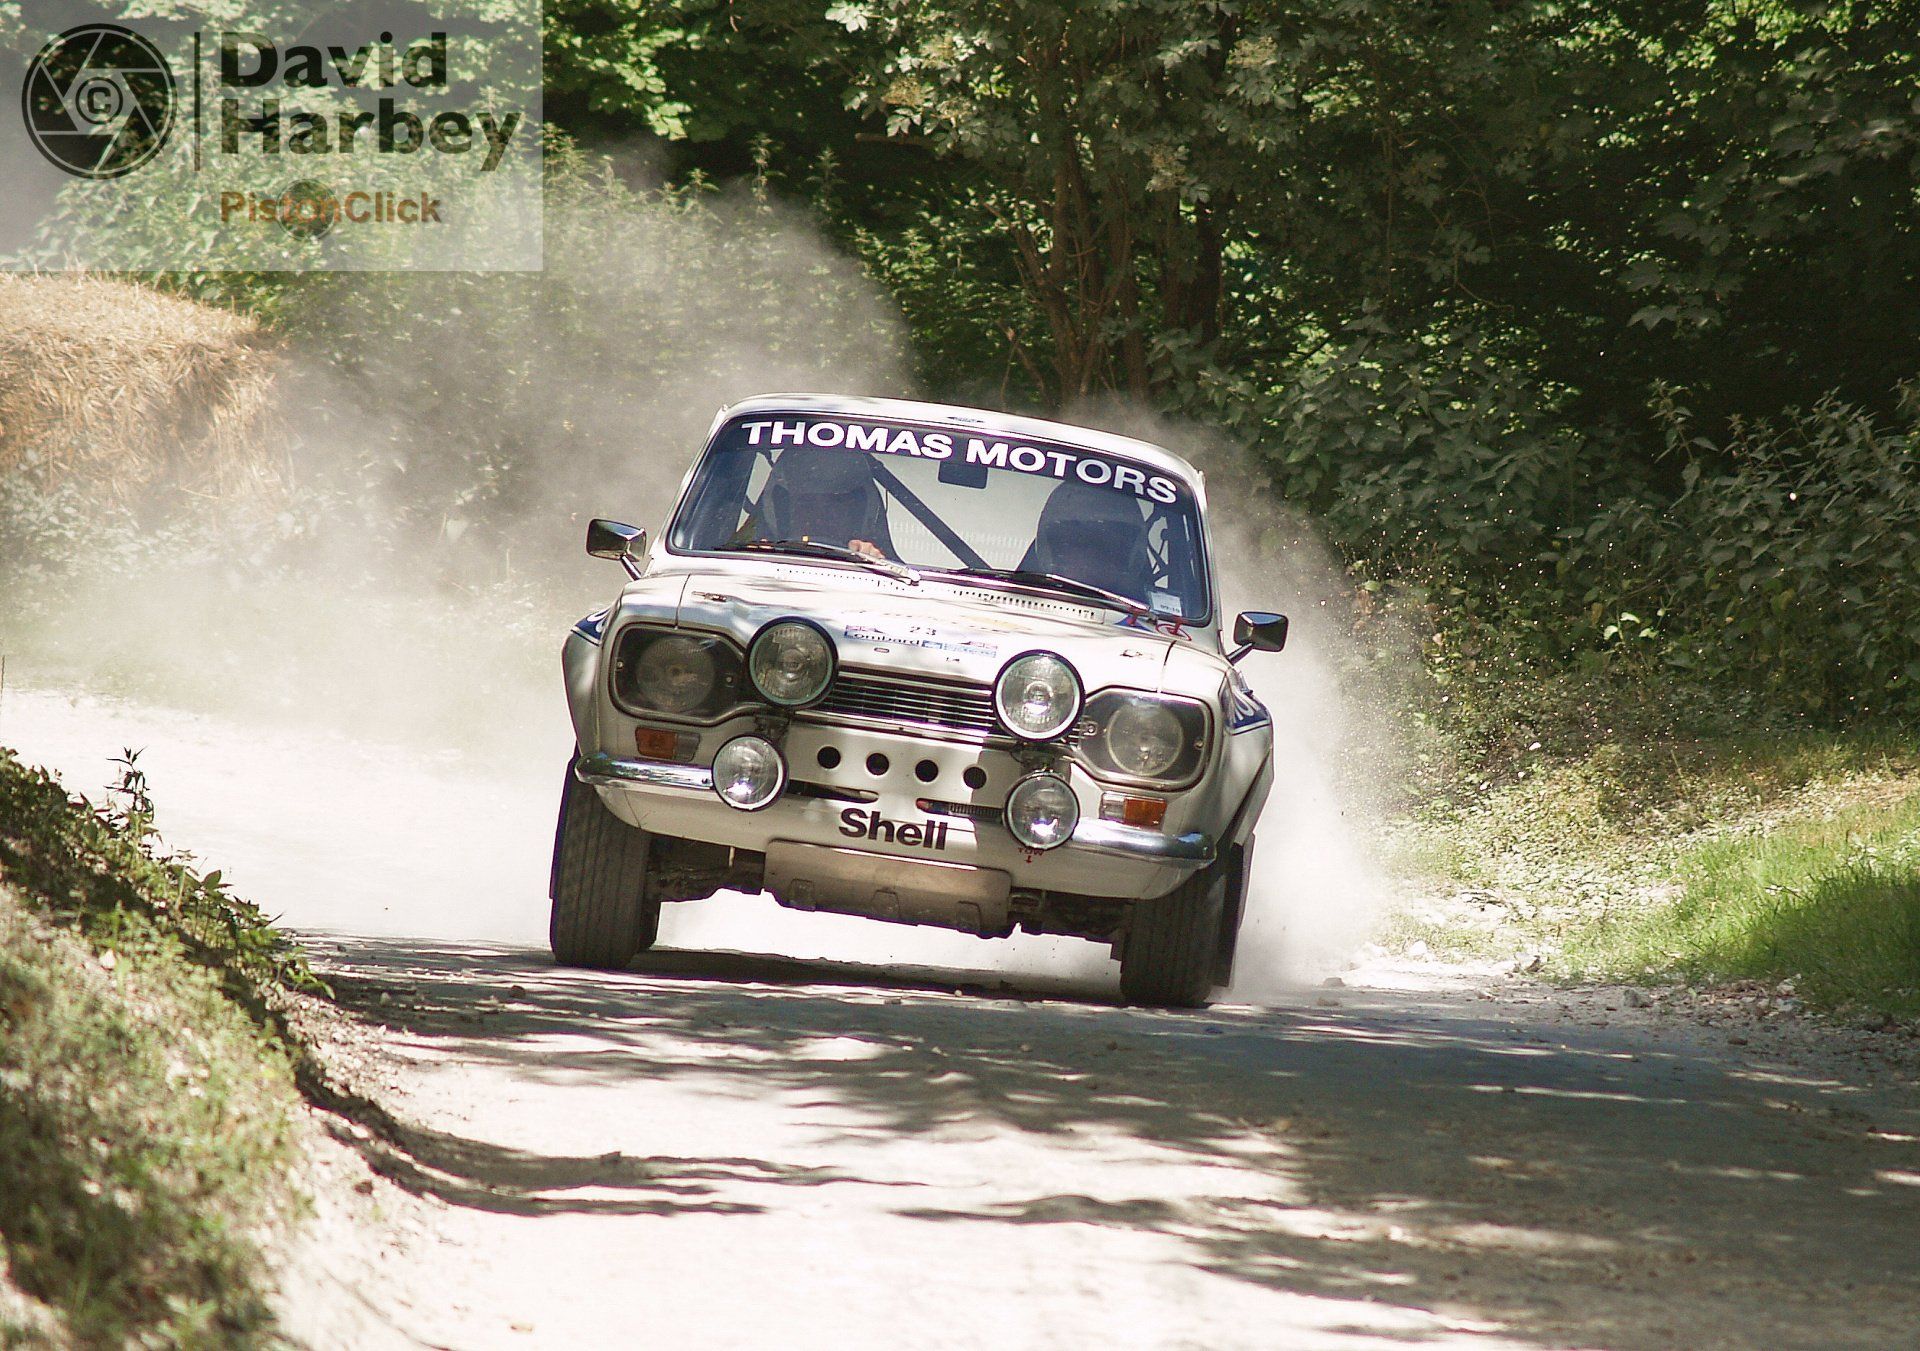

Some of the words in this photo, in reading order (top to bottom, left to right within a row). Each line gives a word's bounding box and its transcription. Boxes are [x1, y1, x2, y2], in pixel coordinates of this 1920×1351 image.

[741, 420, 953, 460] THOMAS
[965, 438, 1178, 505] MOTORS
[838, 807, 949, 851] Shell
